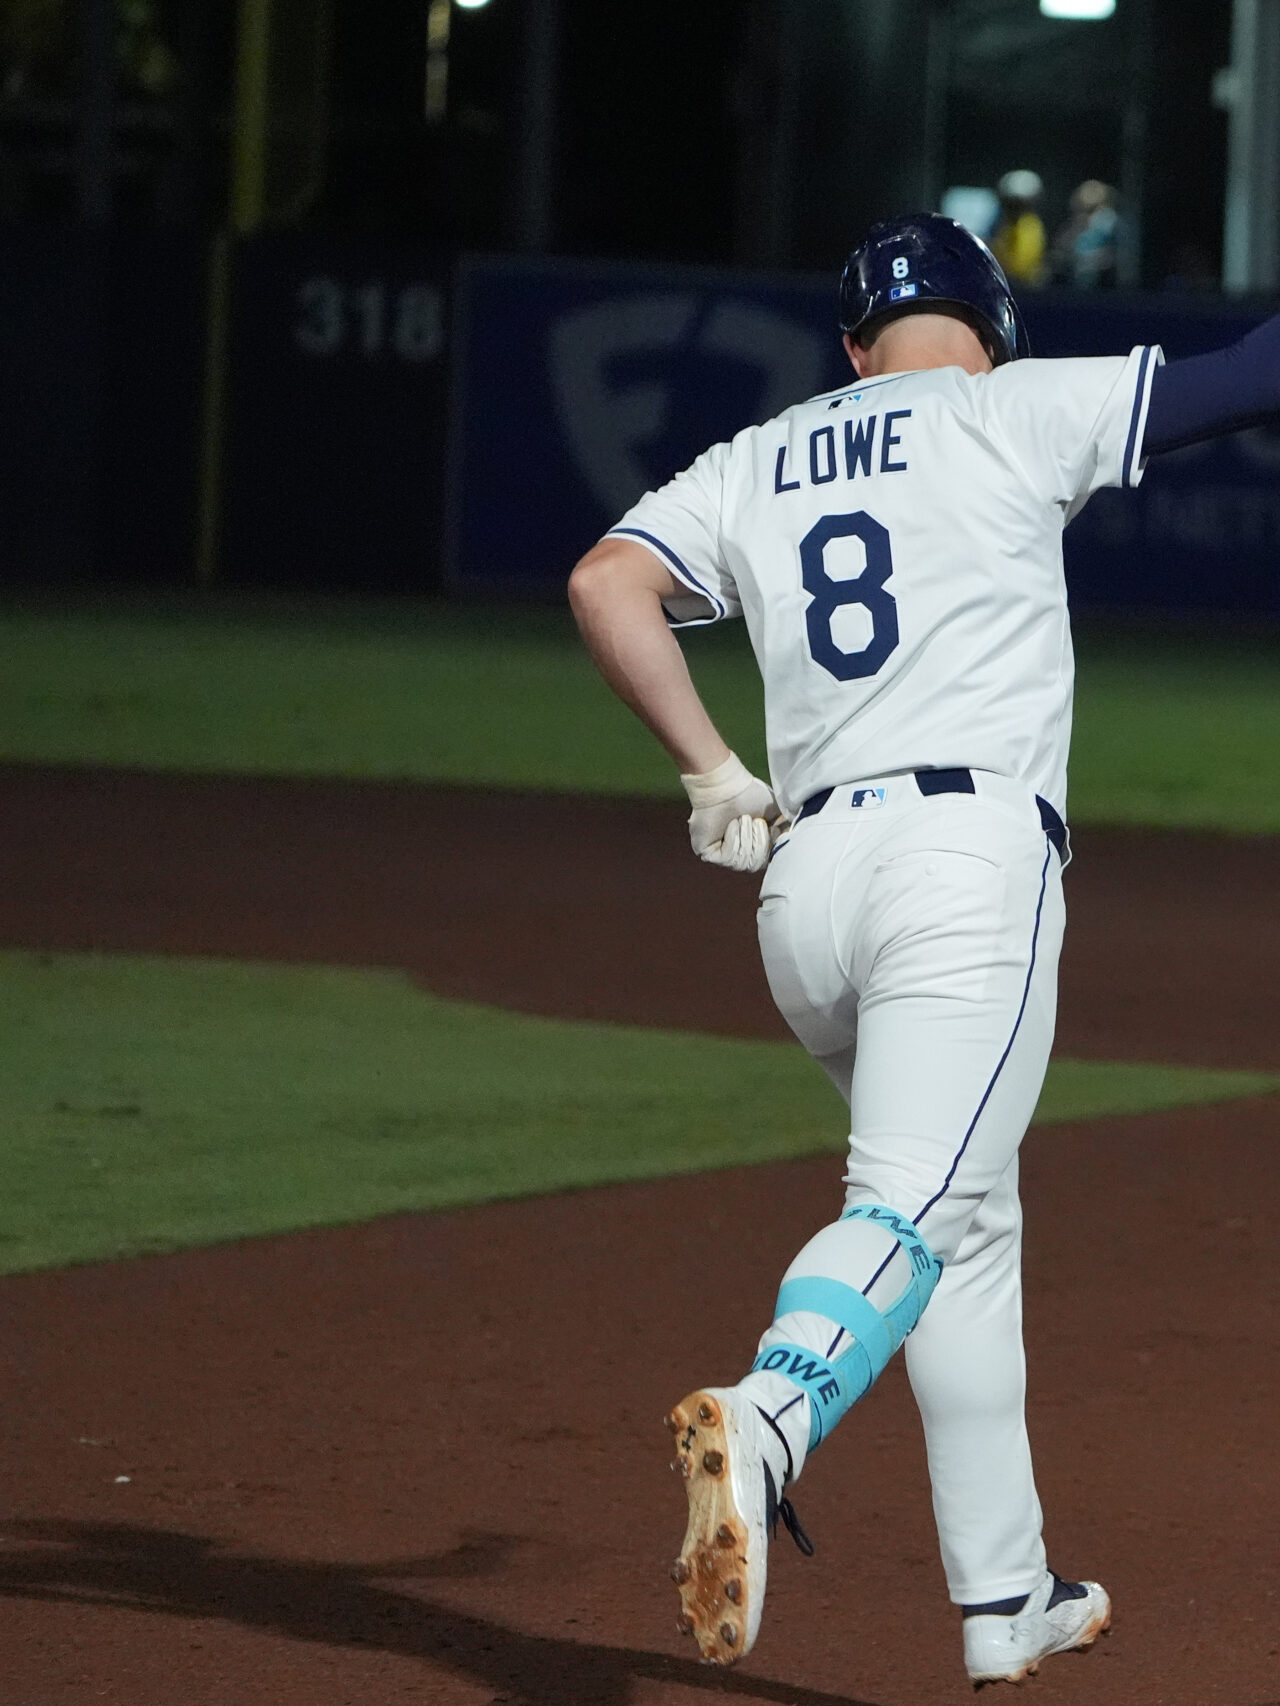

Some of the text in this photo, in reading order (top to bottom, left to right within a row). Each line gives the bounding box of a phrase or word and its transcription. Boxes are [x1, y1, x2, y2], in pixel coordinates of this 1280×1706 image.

[892, 256, 909, 279] 8
[297, 277, 445, 361] 318
[774, 409, 912, 494] LOWE
[799, 510, 900, 682] 8
